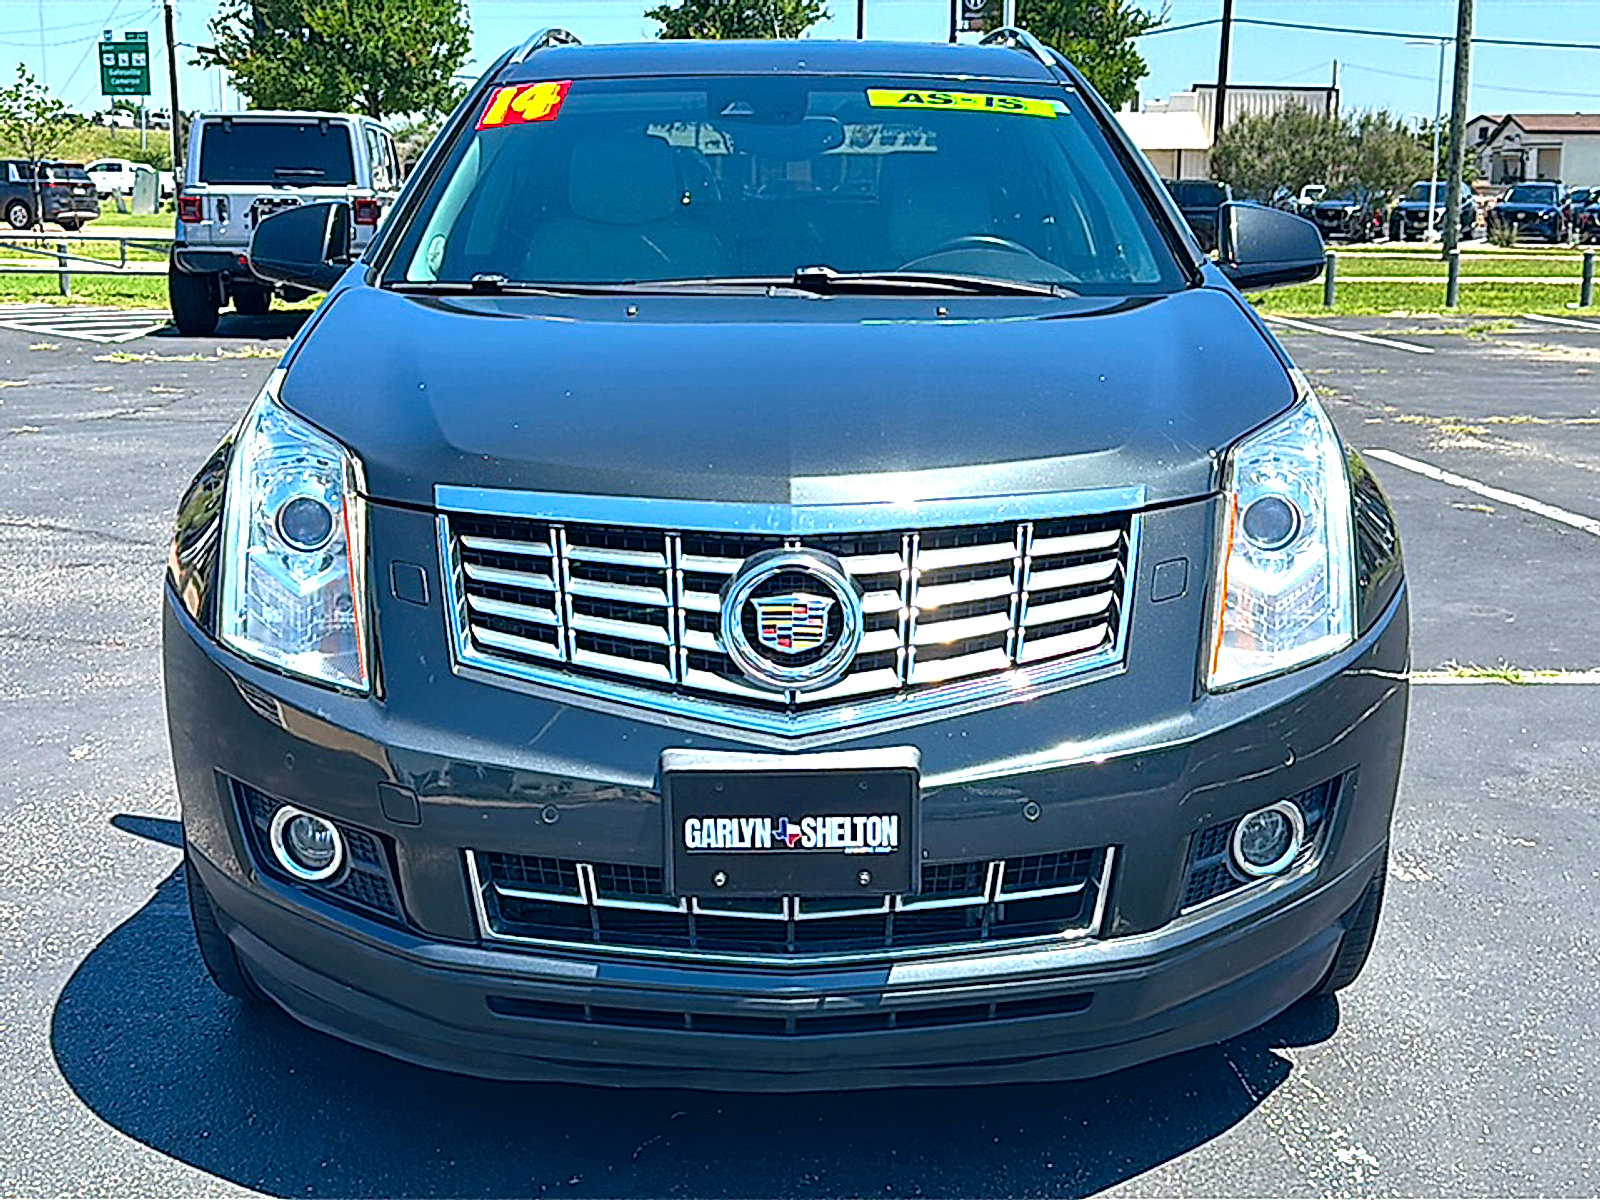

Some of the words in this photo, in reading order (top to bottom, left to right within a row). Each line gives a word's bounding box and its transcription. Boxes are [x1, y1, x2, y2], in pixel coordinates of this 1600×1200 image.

[482, 83, 561, 125] 14
[684, 817, 772, 848] GARLYN
[801, 815, 898, 847] SHELTON
